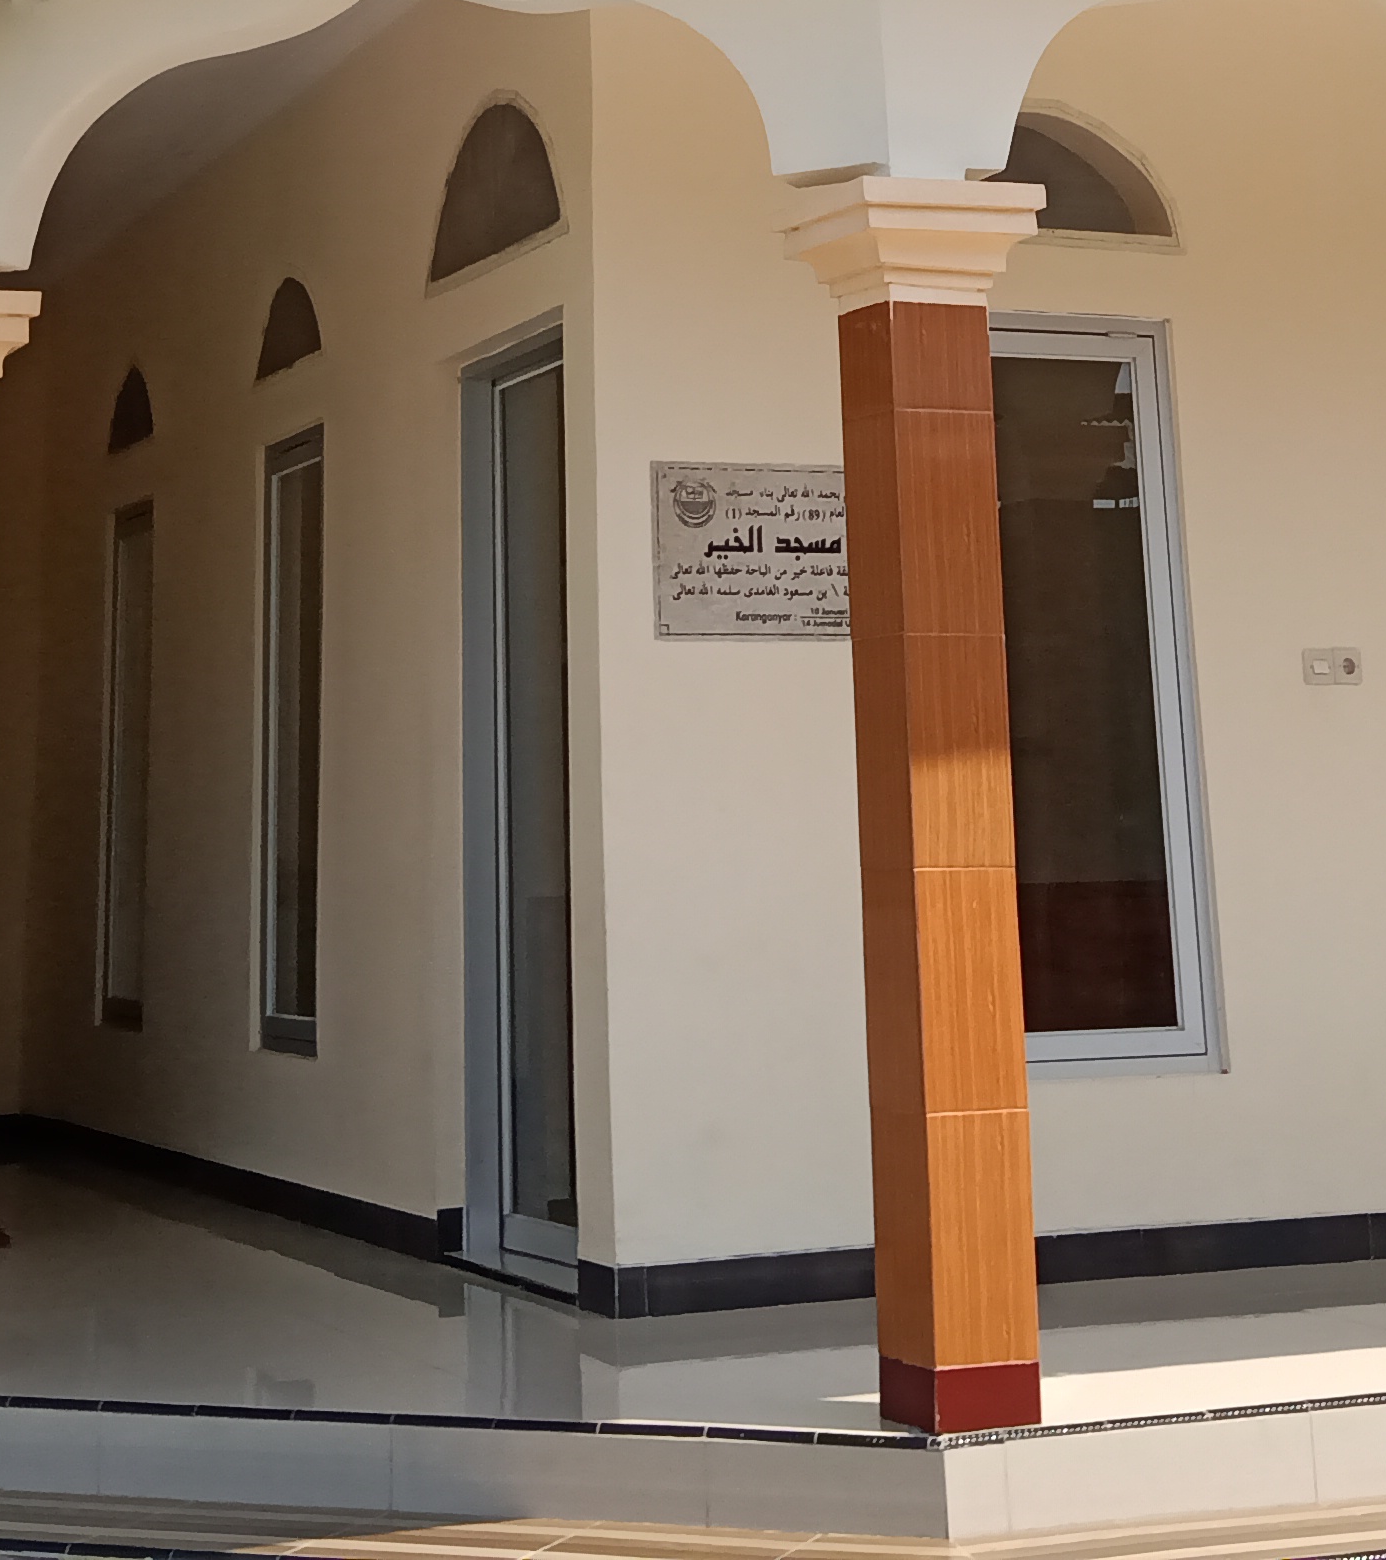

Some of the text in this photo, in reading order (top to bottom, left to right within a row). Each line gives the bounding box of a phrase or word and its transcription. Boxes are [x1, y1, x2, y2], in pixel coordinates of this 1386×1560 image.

[801, 483, 814, 498] الله
[725, 507, 742, 520] (1)
[745, 505, 781, 518] المسجد
[704, 525, 841, 561] مسجد الخير
[696, 560, 709, 575] الله
[699, 581, 713, 595] الله
[736, 611, 792, 624] Karanganyar
